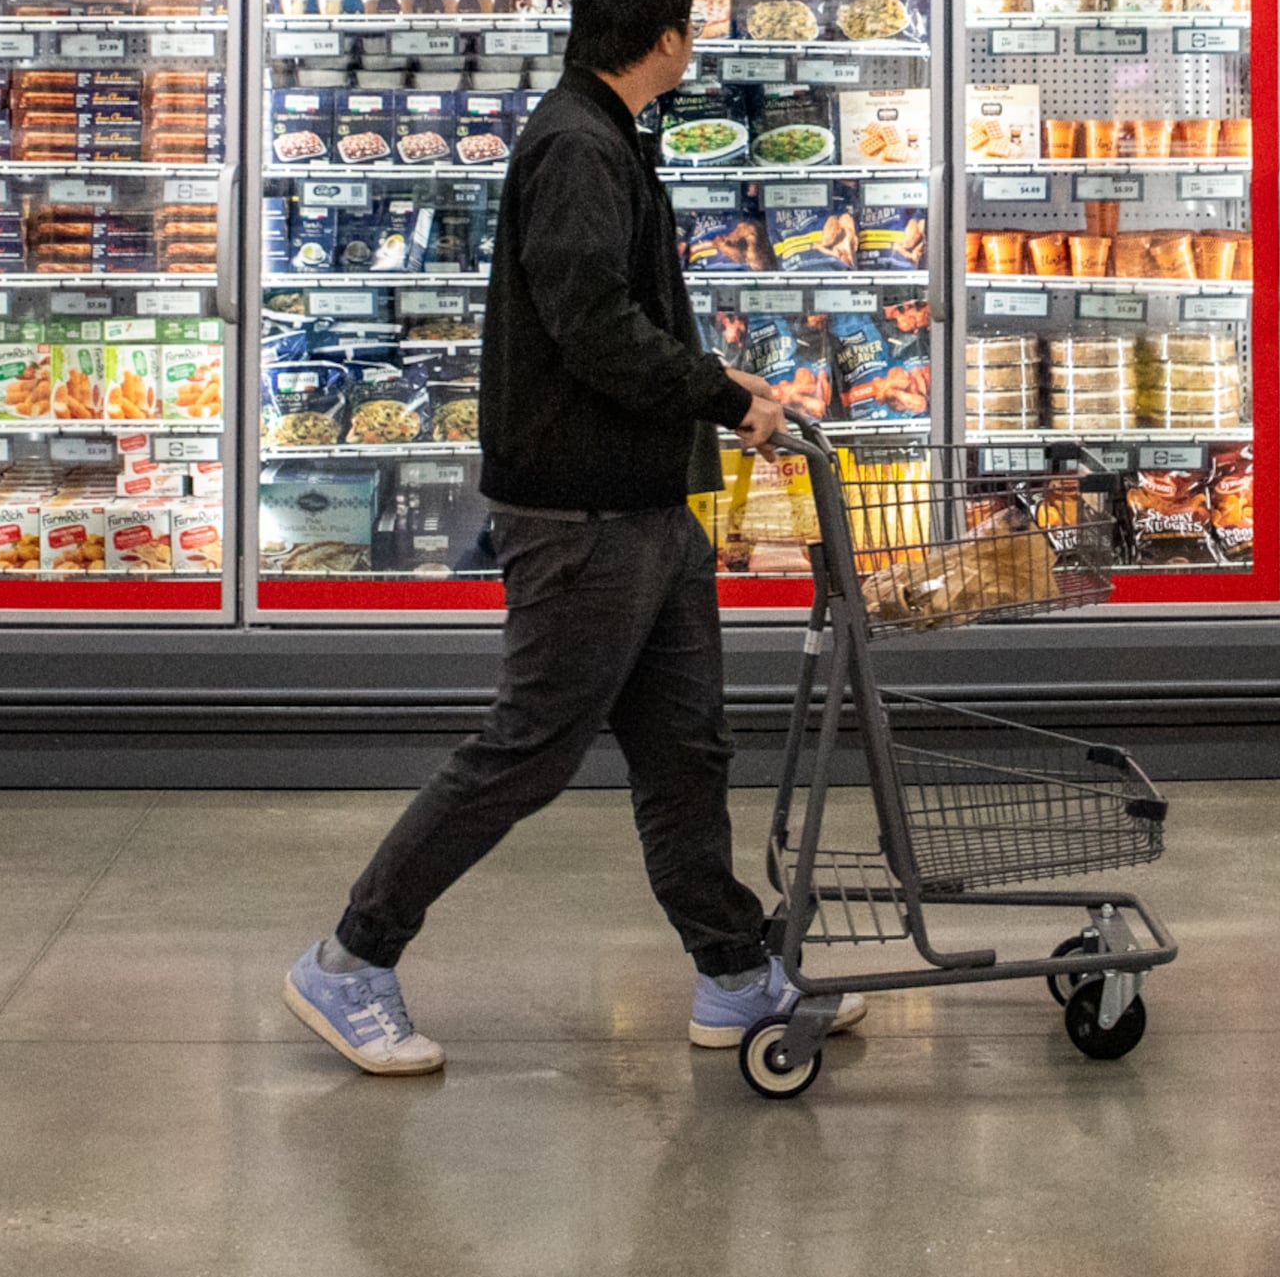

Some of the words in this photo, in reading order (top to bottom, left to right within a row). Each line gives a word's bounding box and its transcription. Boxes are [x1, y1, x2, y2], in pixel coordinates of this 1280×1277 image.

[42, 509, 89, 525] FarmRich
[107, 510, 156, 526] FarmRich
[1147, 509, 1193, 524] SPOOKY
